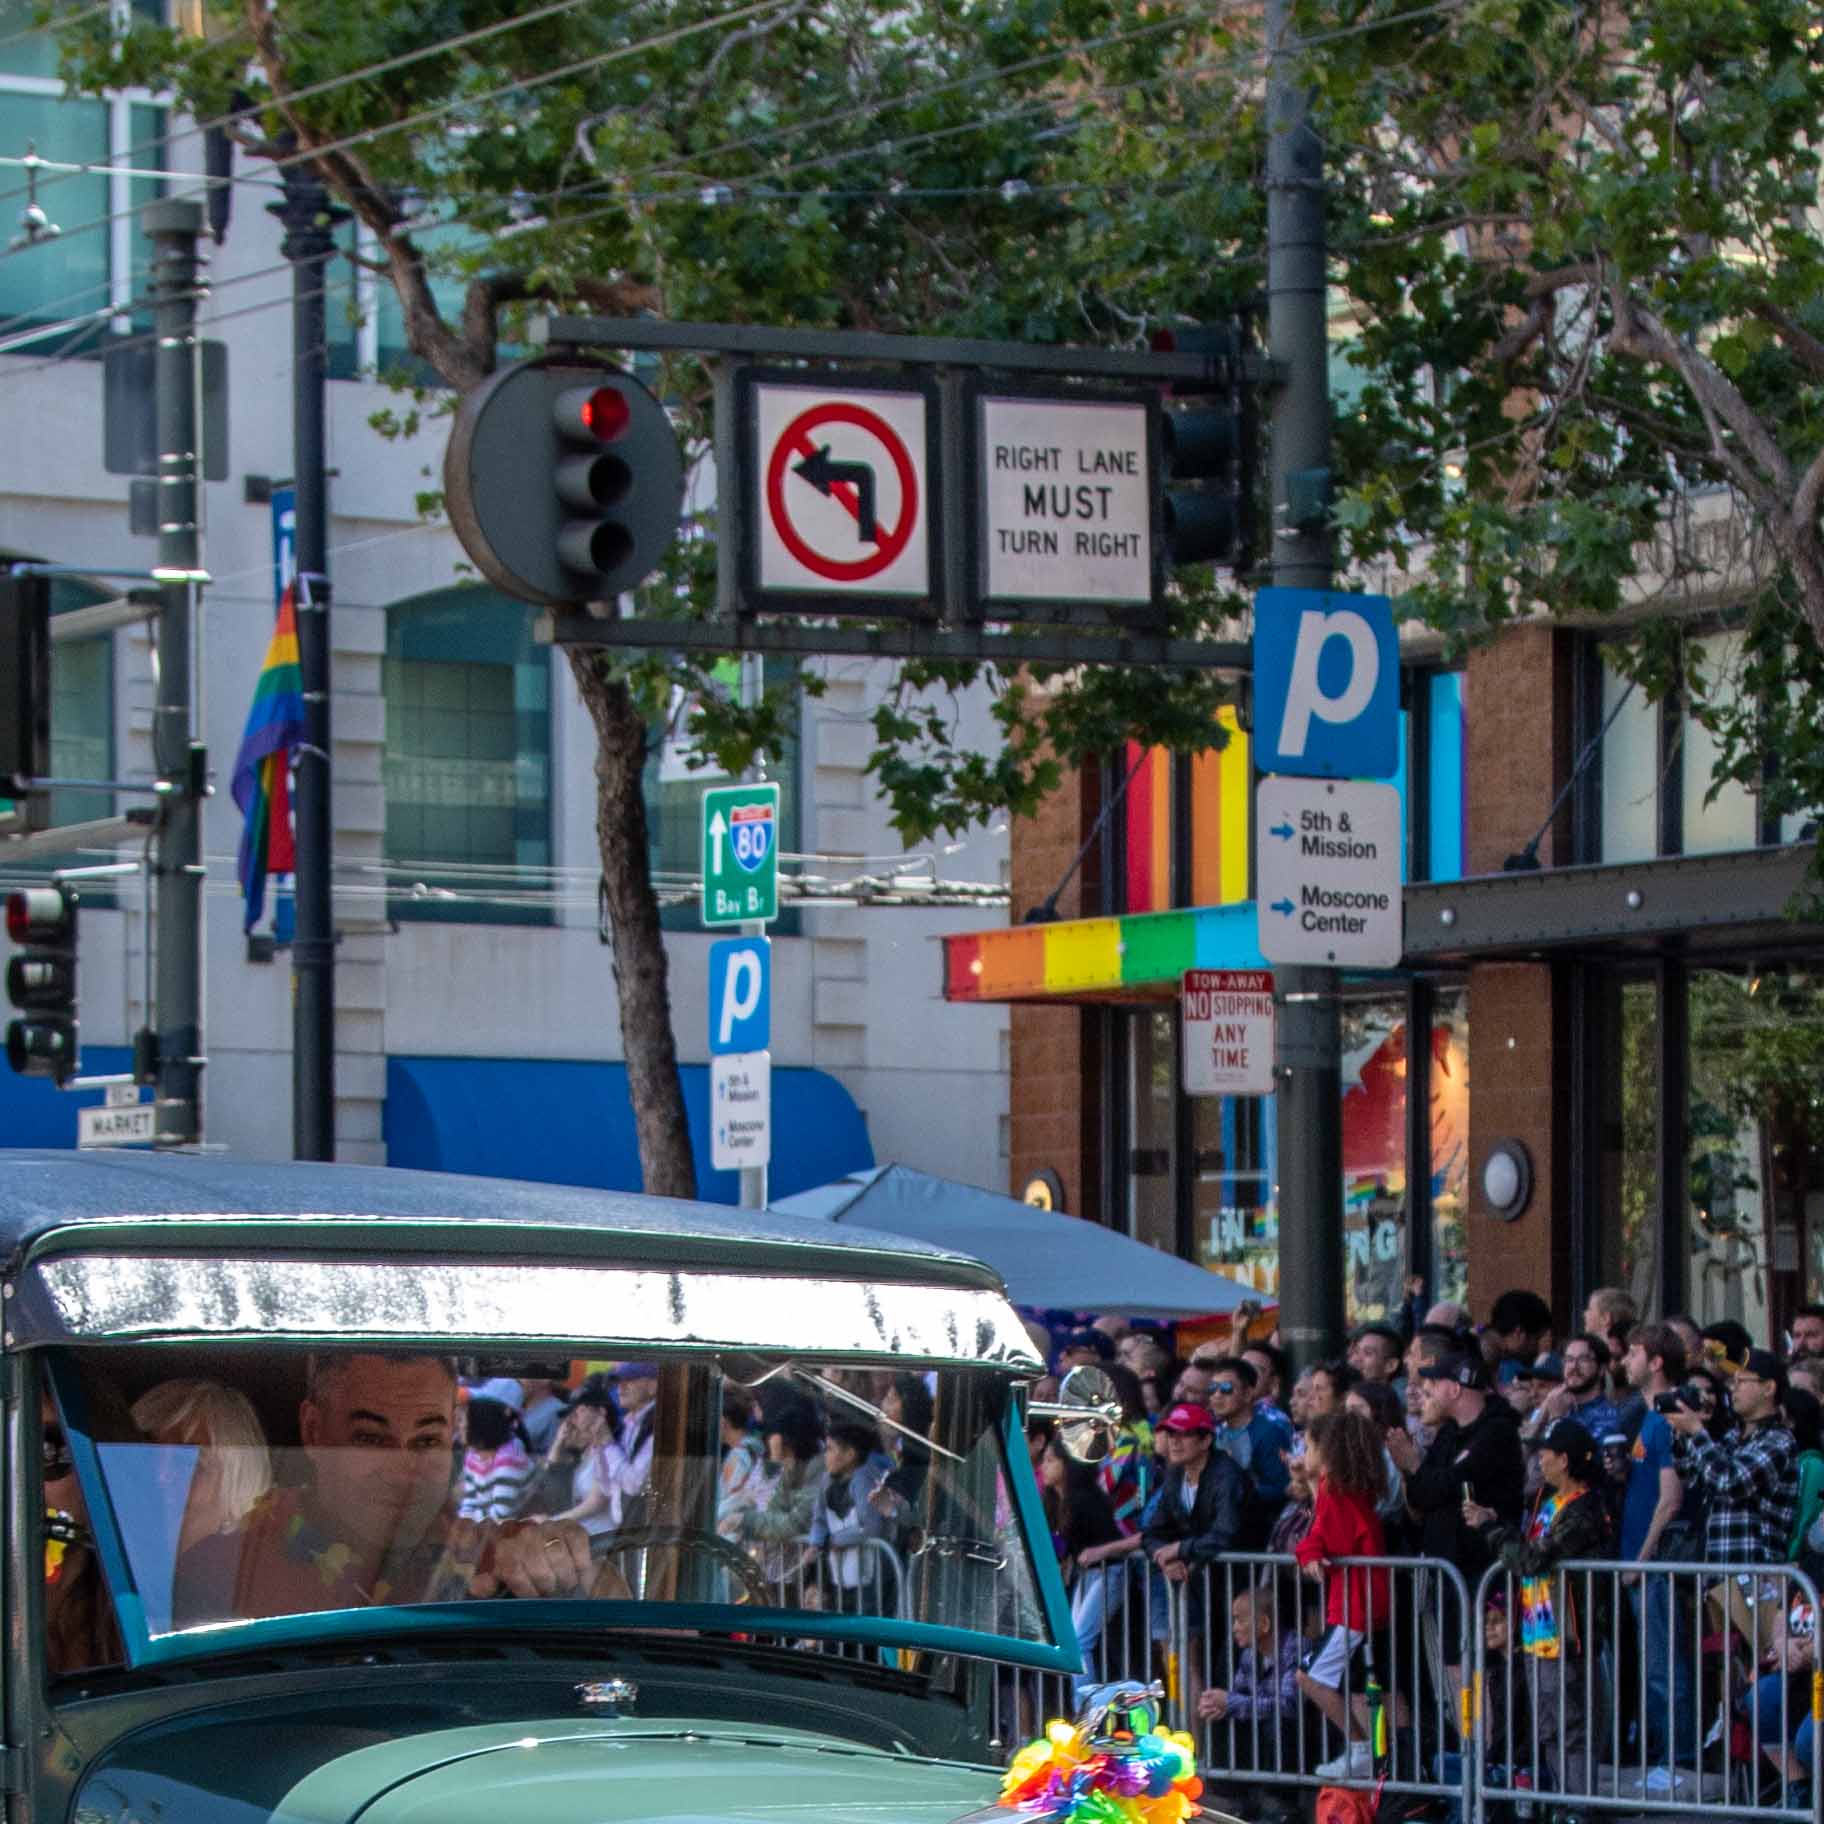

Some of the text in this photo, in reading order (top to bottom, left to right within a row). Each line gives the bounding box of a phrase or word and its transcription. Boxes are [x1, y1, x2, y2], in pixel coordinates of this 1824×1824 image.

[995, 446, 1139, 475] RIGHT LANE
[1024, 483, 1113, 520] MUST
[998, 529, 1141, 558] TURN RIGHT
[1300, 810, 1352, 834] 5th &
[737, 824, 766, 860] 80
[1301, 836, 1377, 860] Mission
[716, 886, 764, 917] Bay Br
[1301, 886, 1389, 911] Moscone
[1301, 912, 1367, 934] Center
[1193, 973, 1265, 990] TOW-AWAY
[1185, 993, 1273, 1018] NO STOPPING
[1214, 1023, 1248, 1043] ANY
[1212, 1047, 1249, 1069] TIME
[92, 1112, 152, 1135] MARKET
